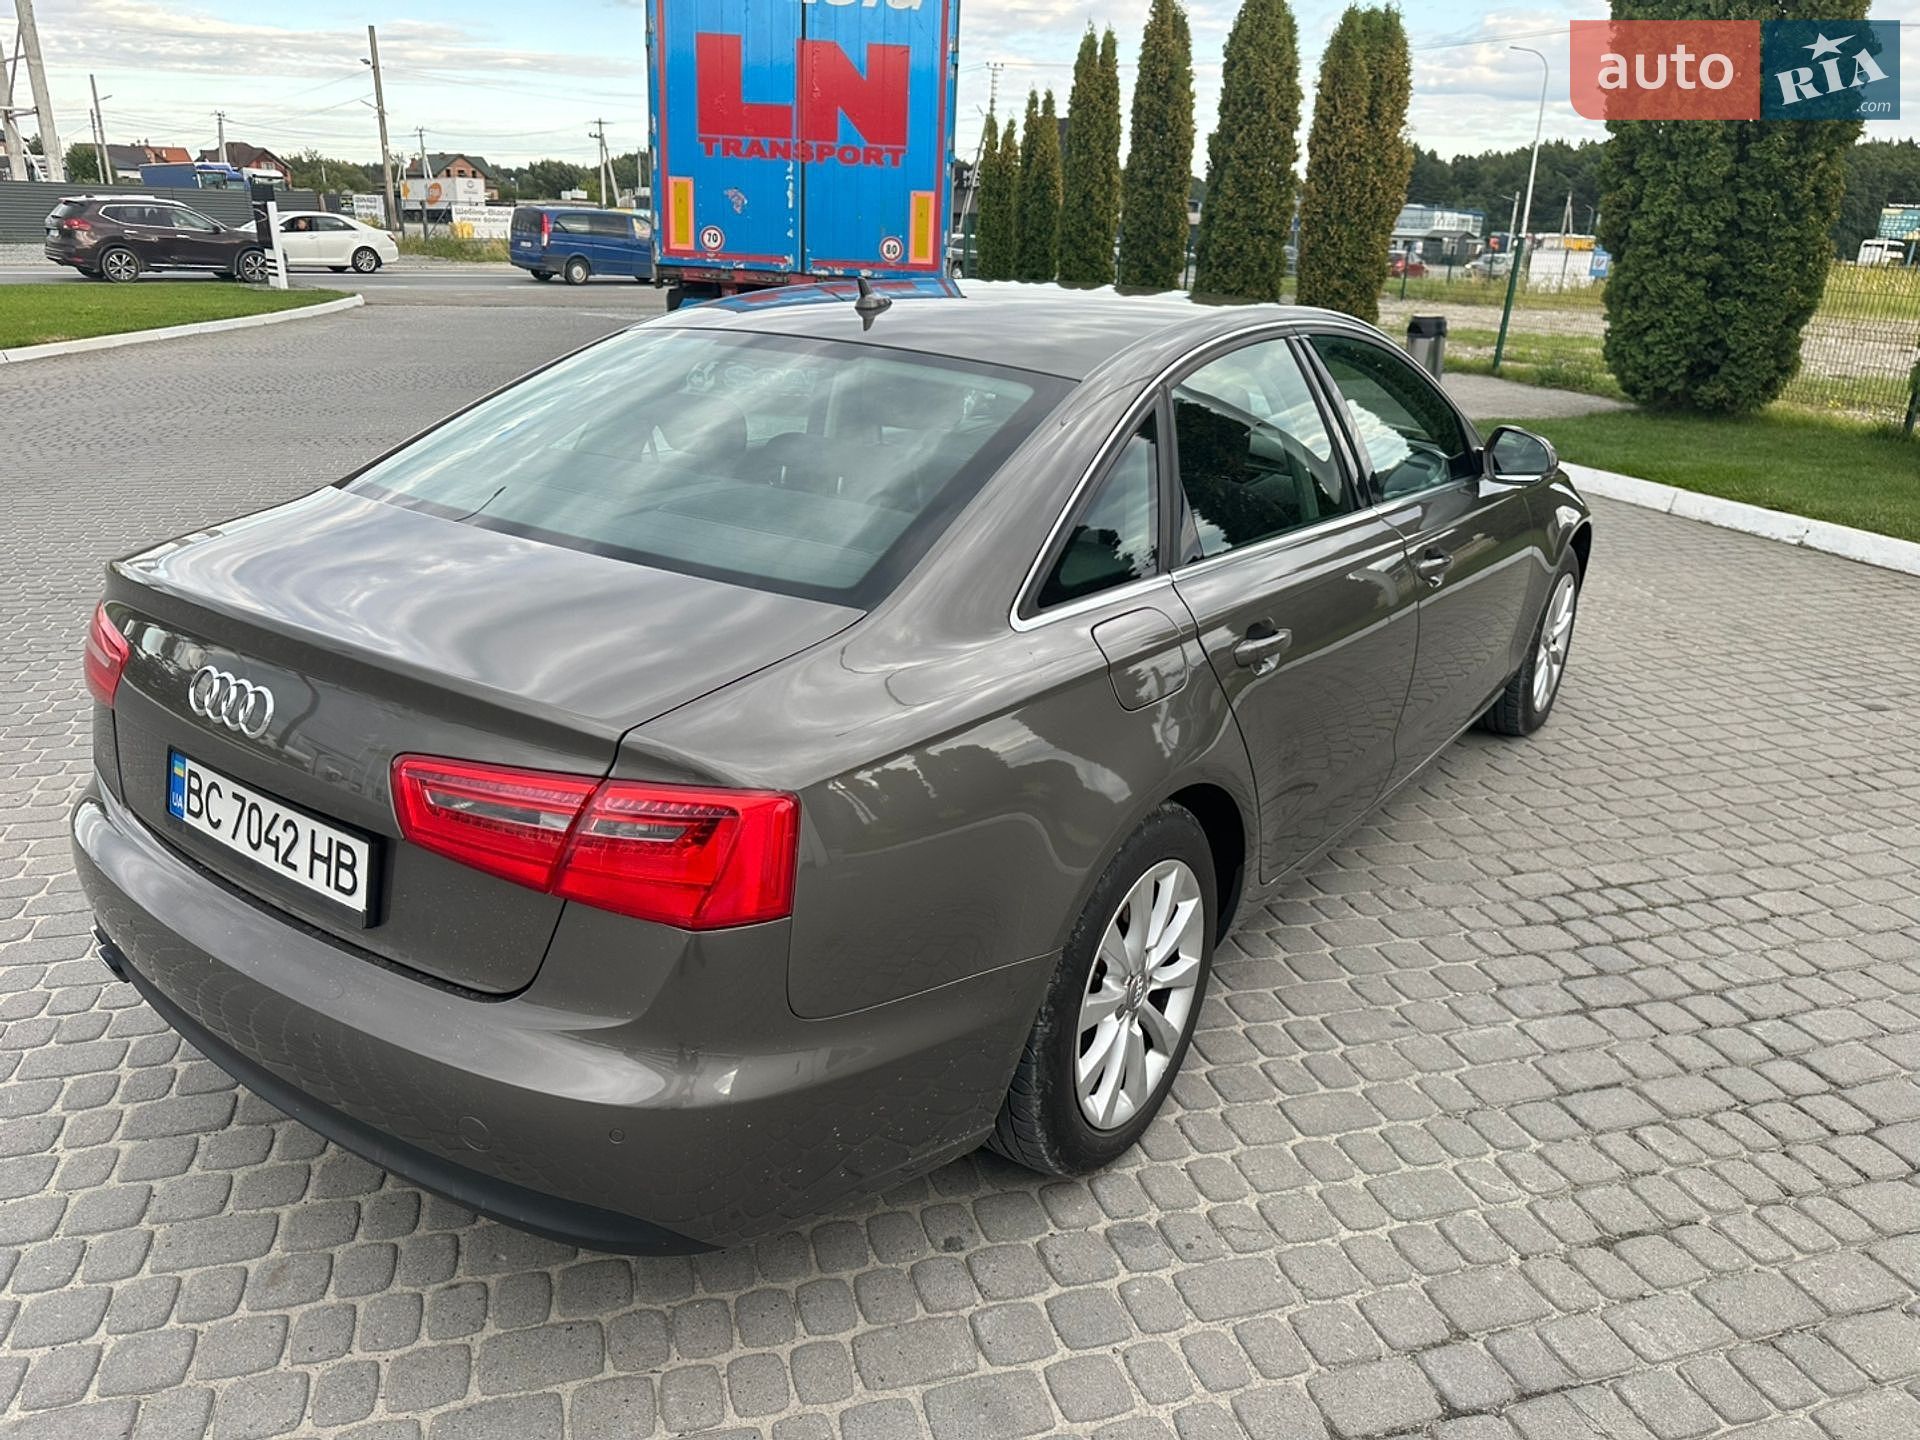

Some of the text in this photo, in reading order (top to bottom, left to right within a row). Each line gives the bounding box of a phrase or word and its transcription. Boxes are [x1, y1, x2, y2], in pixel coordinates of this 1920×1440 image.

[696, 33, 911, 146] LN
[698, 138, 909, 167] TRANSPORT
[706, 233, 719, 243] 70
[886, 244, 898, 255] 80
[171, 791, 184, 809] UA
[187, 769, 359, 896] BC 7042 HB
